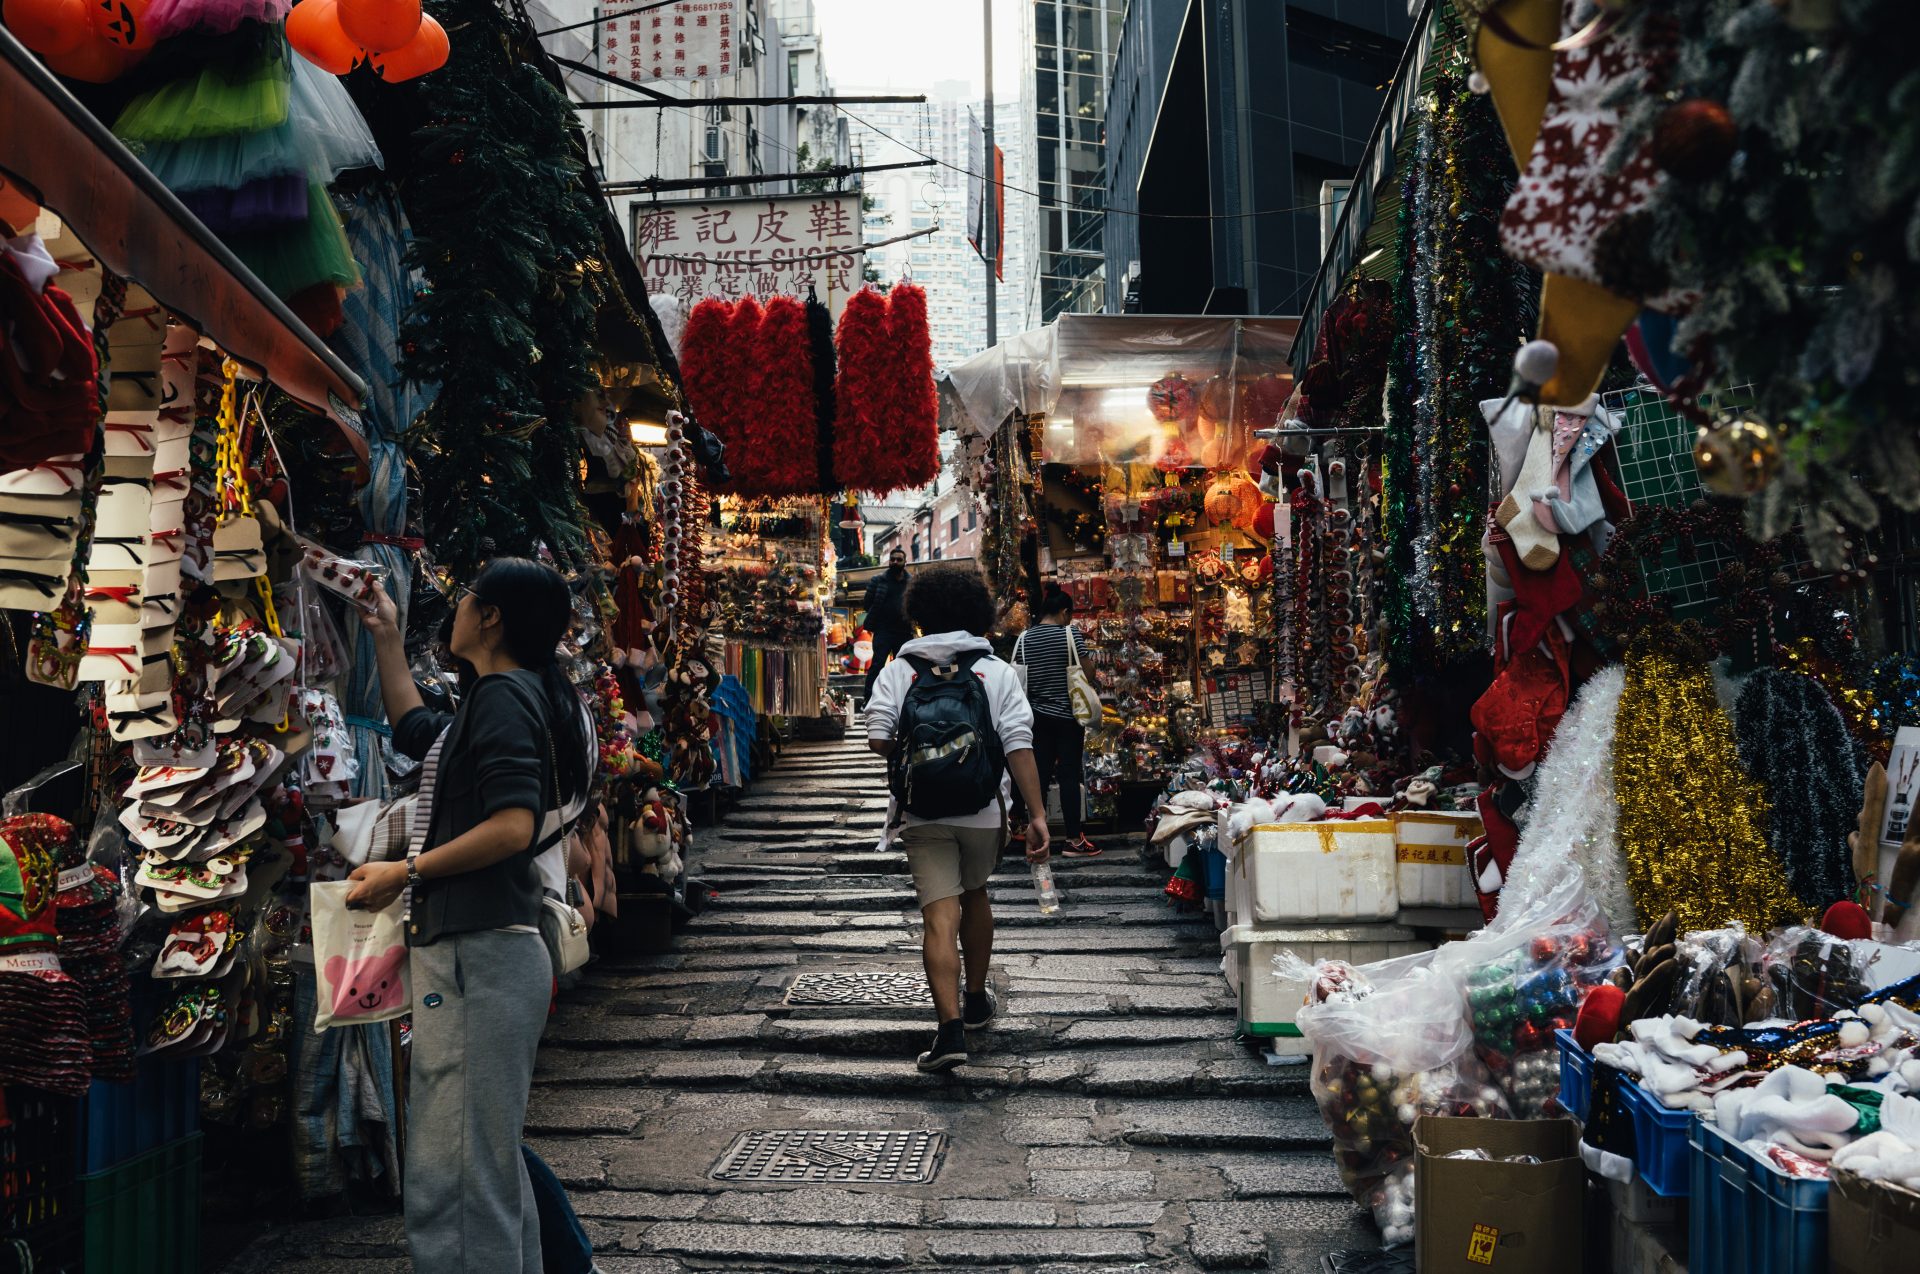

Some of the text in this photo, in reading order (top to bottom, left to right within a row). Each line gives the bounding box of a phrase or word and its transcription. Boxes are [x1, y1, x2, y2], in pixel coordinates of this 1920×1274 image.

[638, 199, 853, 250] 雍記皮鞋
[717, 249, 762, 274] KEE
[771, 245, 855, 272] SHOES
[59, 872, 81, 885] erry
[6, 958, 44, 969] Merry
